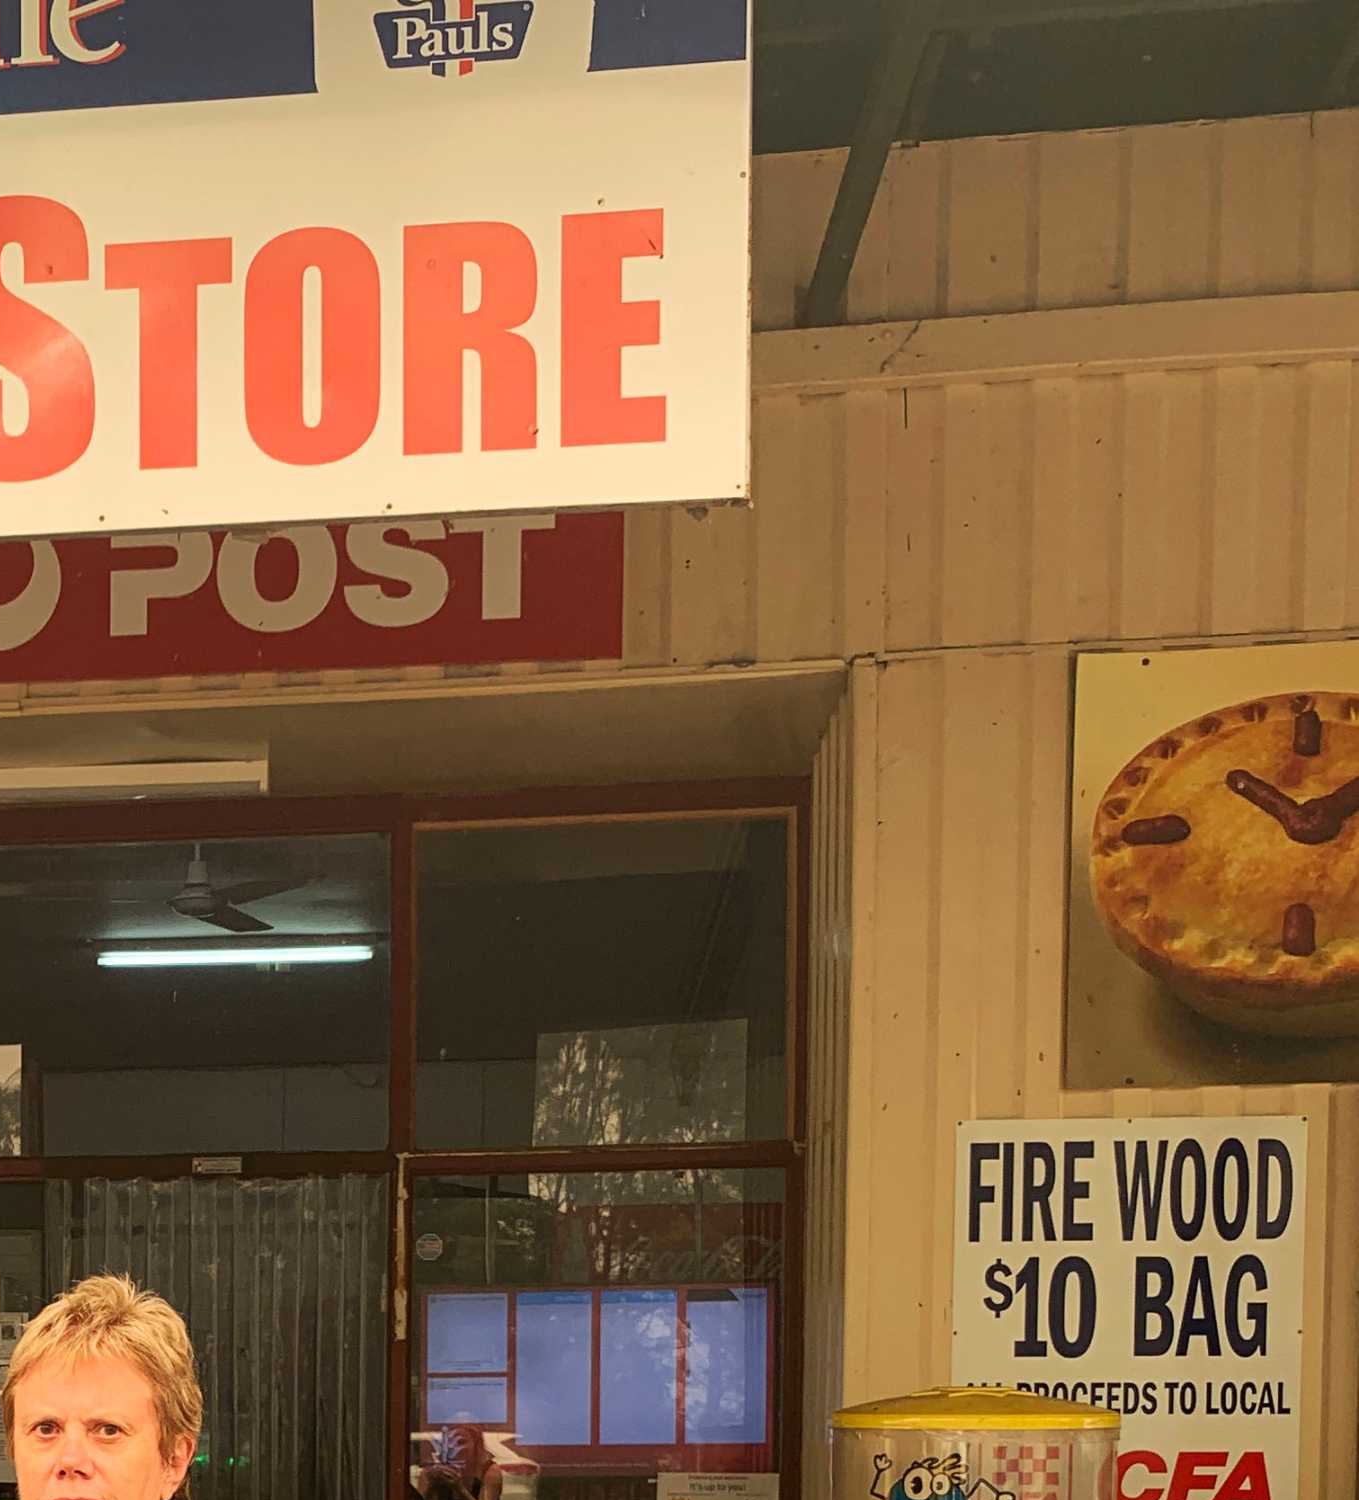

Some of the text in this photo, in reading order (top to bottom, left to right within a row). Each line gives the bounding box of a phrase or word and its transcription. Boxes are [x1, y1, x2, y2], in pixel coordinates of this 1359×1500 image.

[392, 11, 514, 59] Pauls
[110, 513, 555, 636] POST
[969, 1138, 1293, 1242] FIRE WOOD
[983, 1254, 1268, 1359] $10 BAG
[1017, 1382, 1291, 1416] OCEEDS TO LOCAL
